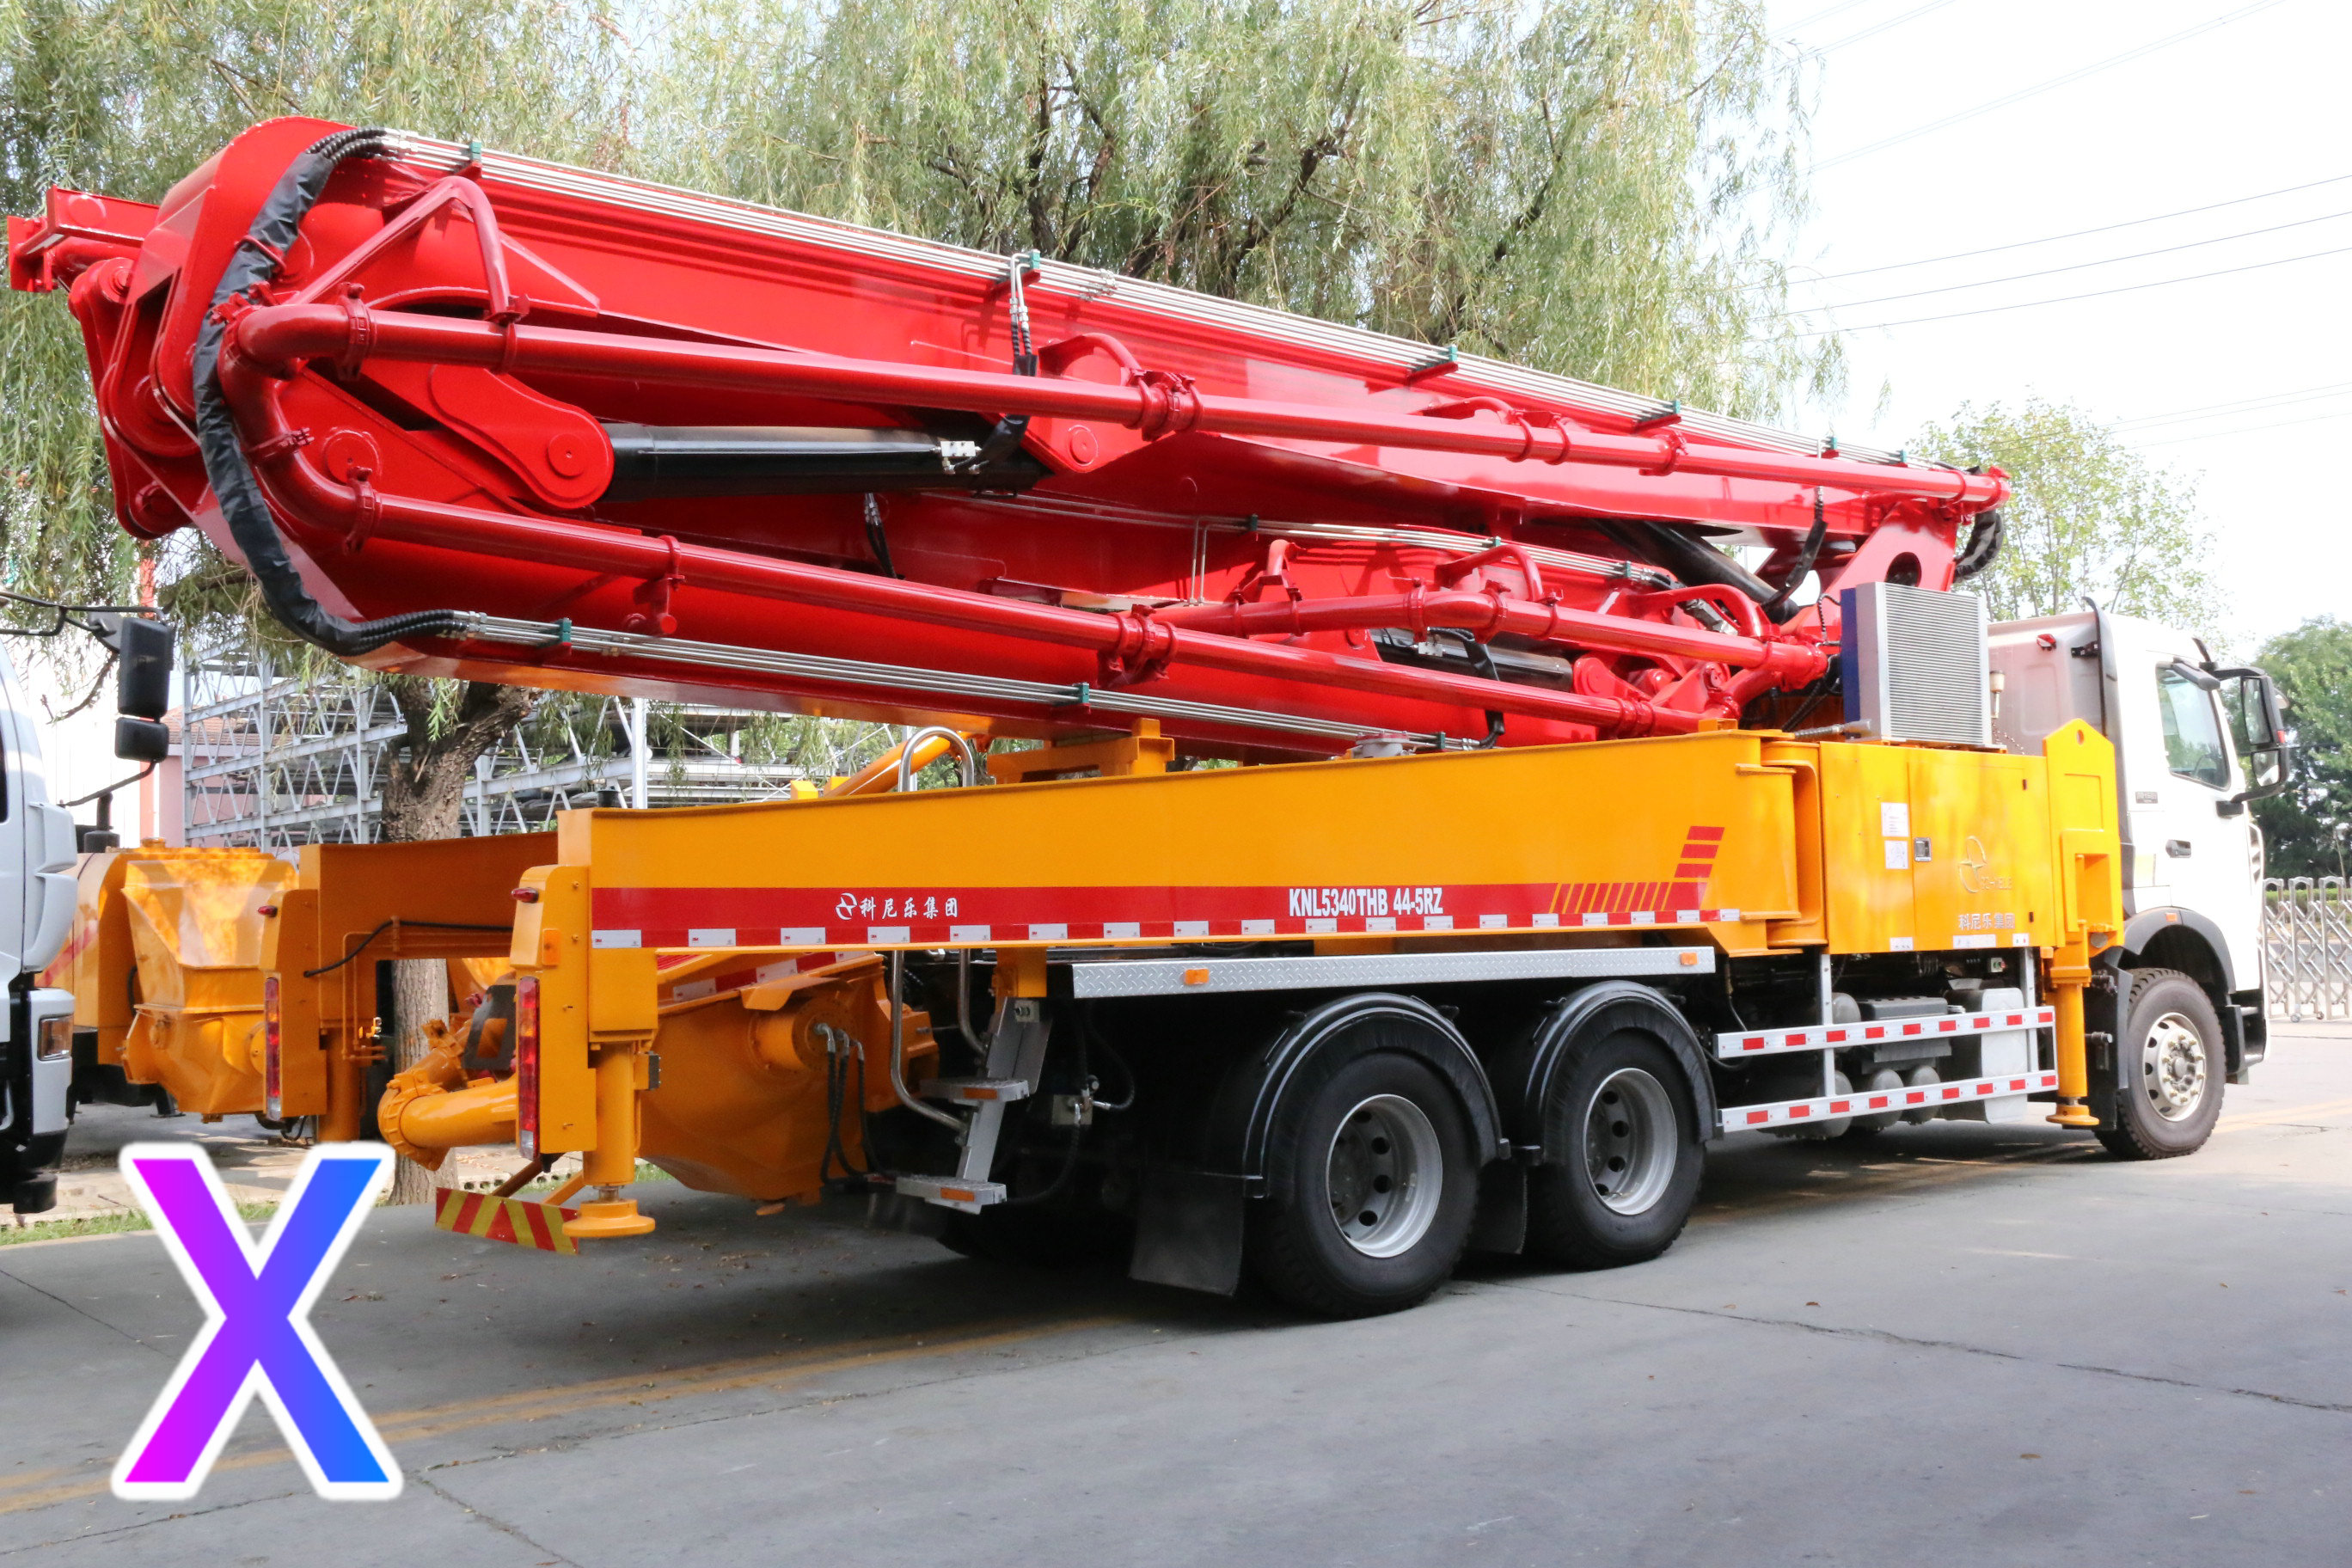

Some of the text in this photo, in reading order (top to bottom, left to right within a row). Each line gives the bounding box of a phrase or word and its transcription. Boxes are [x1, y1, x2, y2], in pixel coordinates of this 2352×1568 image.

[860, 896, 958, 921] 科尼乐集团
[1289, 887, 1444, 917] KNL5340THB 44-5RZ
[1958, 913, 2014, 930] 科尼乐集团
